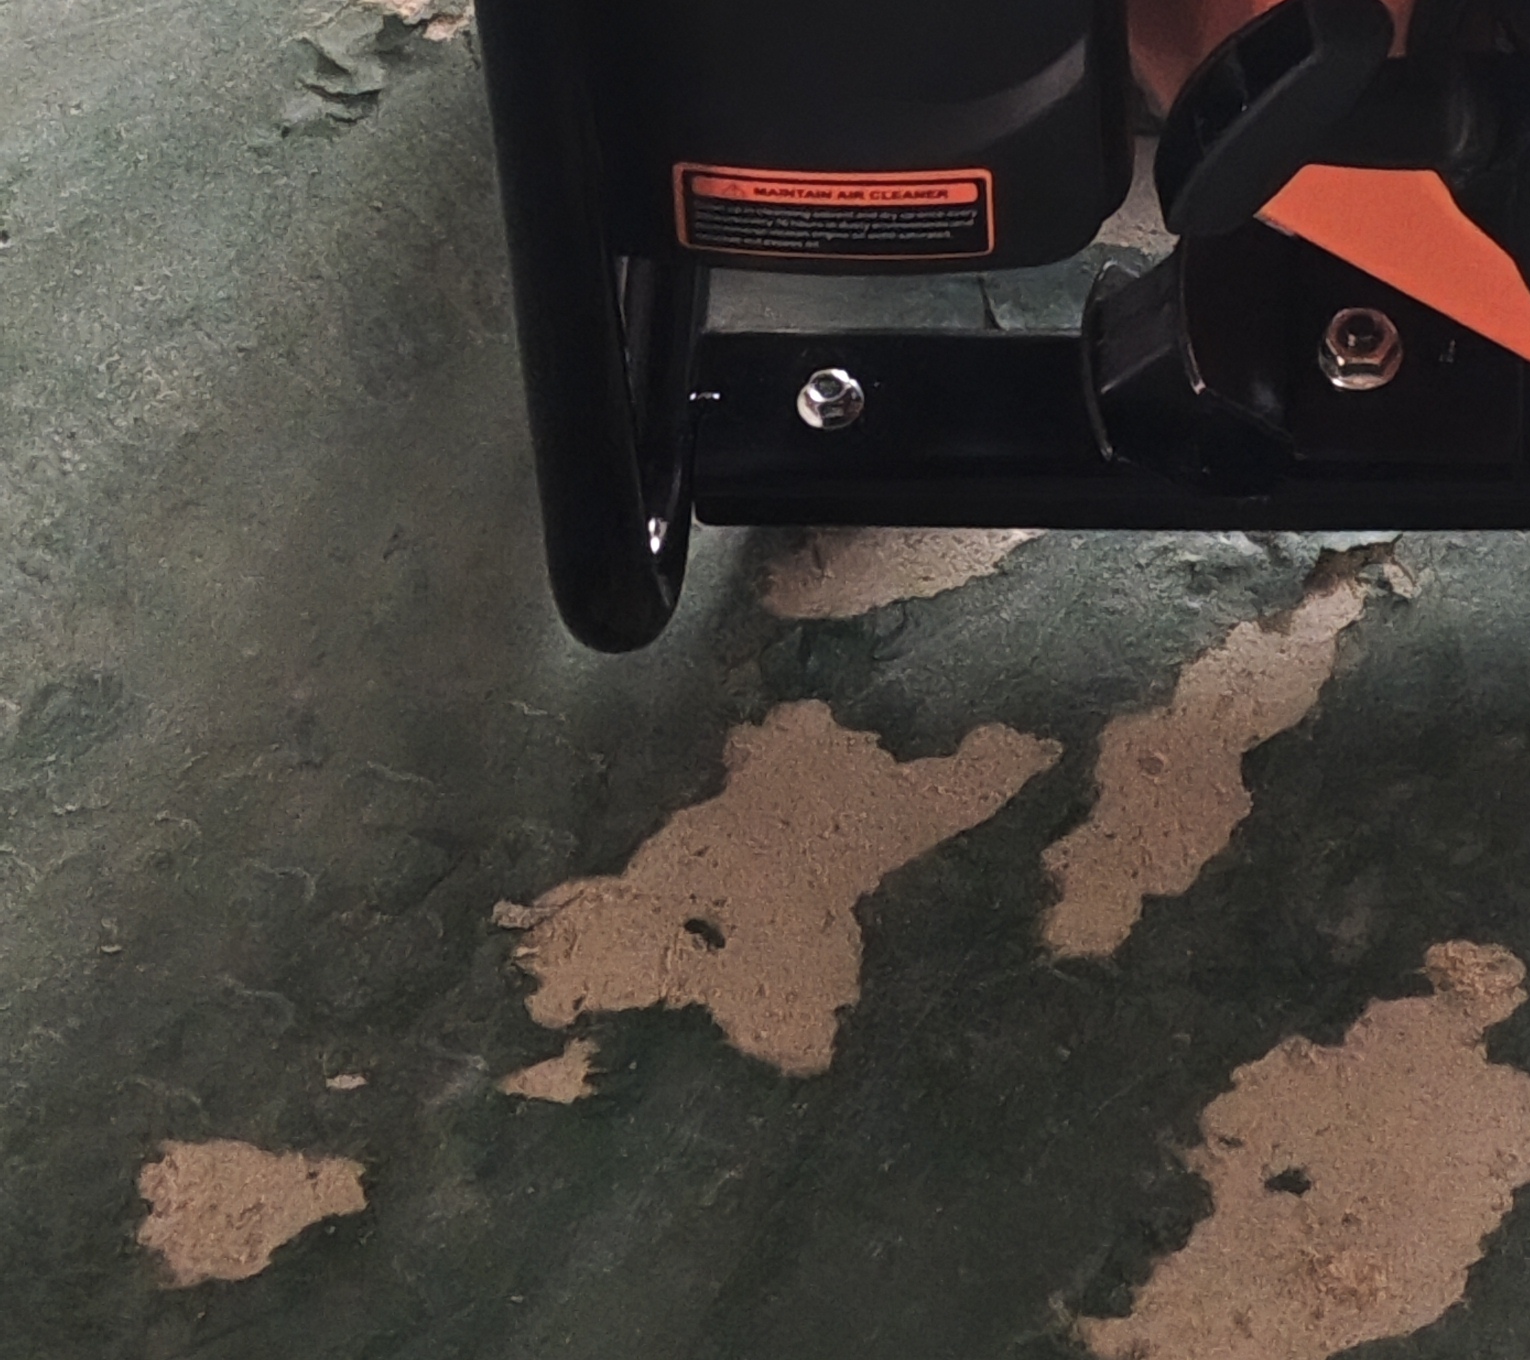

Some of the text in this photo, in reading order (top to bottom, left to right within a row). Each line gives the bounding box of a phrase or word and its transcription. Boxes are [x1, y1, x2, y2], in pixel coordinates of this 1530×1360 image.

[754, 187, 949, 200] MAINTAIN AIR CLEANER
